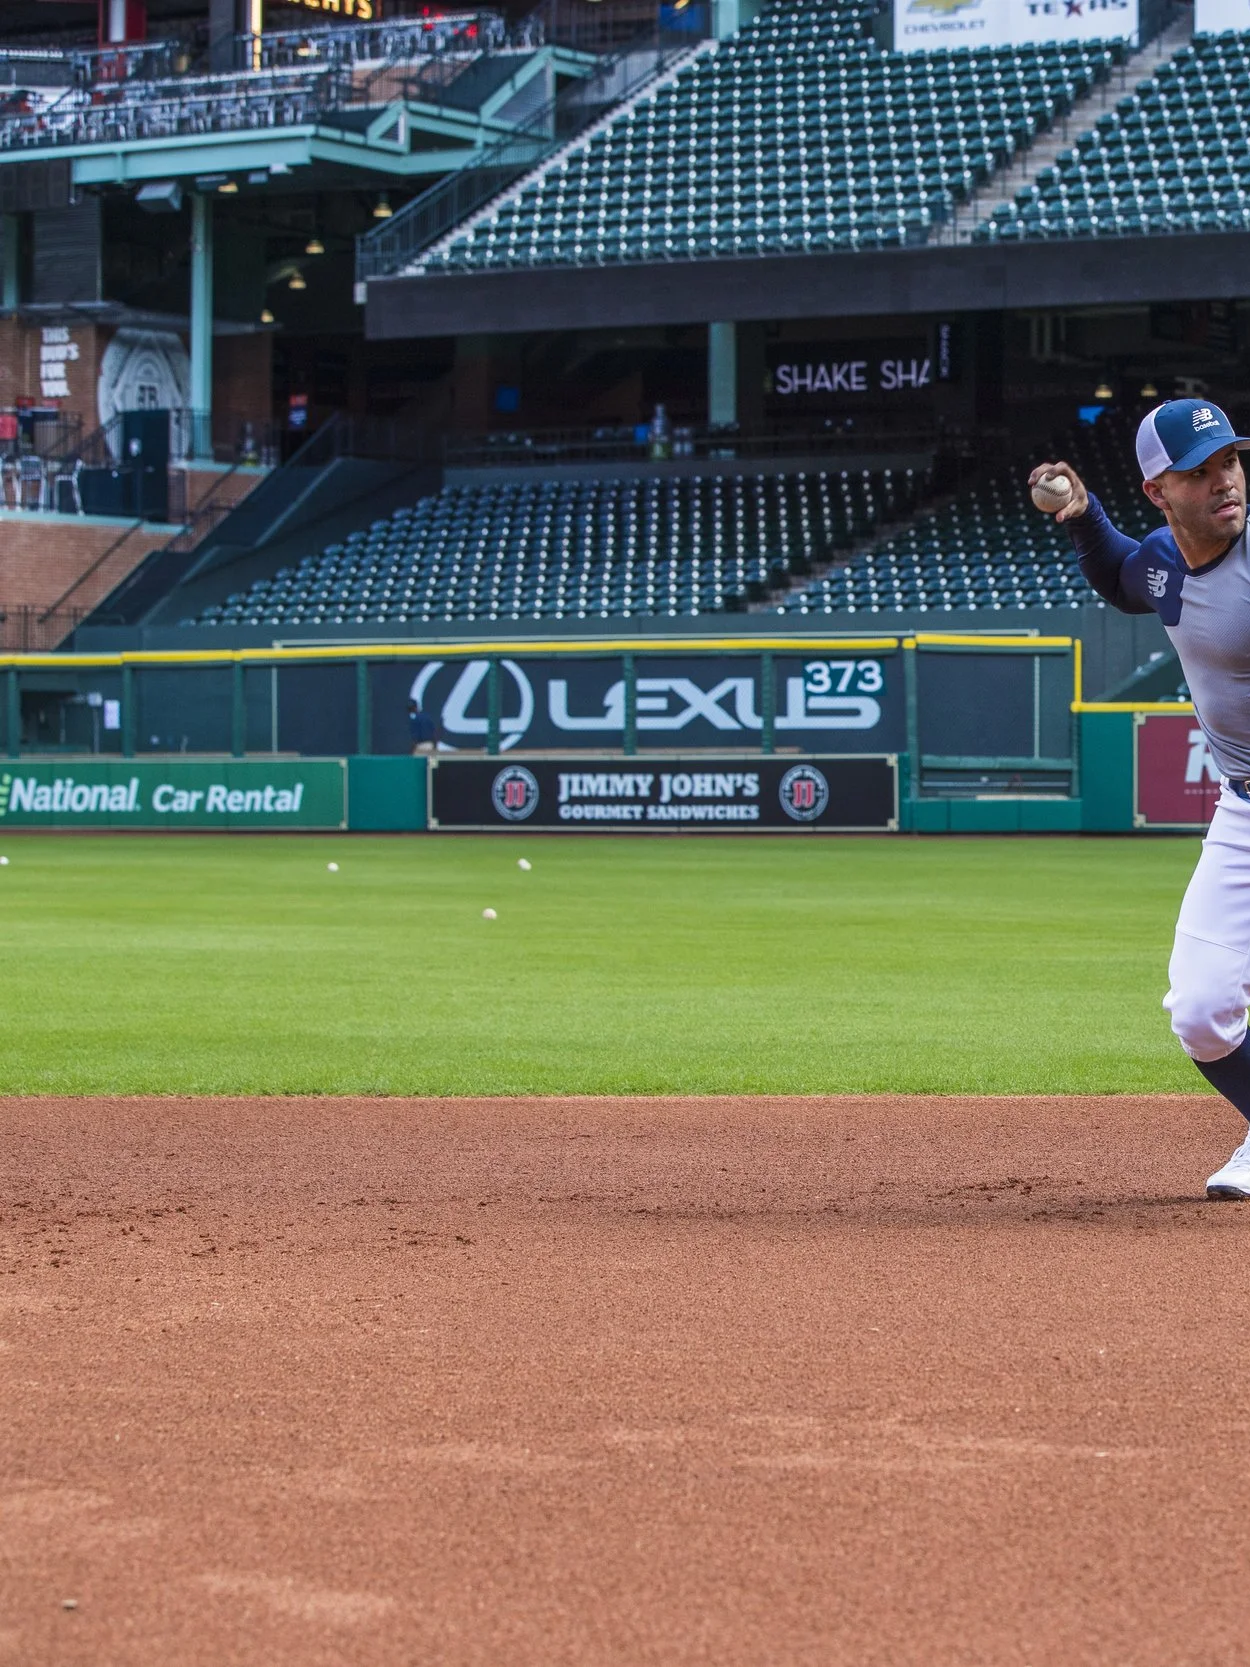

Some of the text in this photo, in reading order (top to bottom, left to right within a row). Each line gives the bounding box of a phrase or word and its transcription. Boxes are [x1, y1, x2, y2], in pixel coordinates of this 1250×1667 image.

[776, 360, 868, 394] SHAKE
[1193, 420, 1220, 432] baseball
[805, 660, 884, 695] 373
[548, 677, 882, 731] LEXUS
[9, 777, 304, 813] National Car Rental
[558, 773, 654, 803] JIMMY
[659, 773, 760, 803] JOHN'S
[559, 804, 760, 820] GOURMET SANDWICHES
